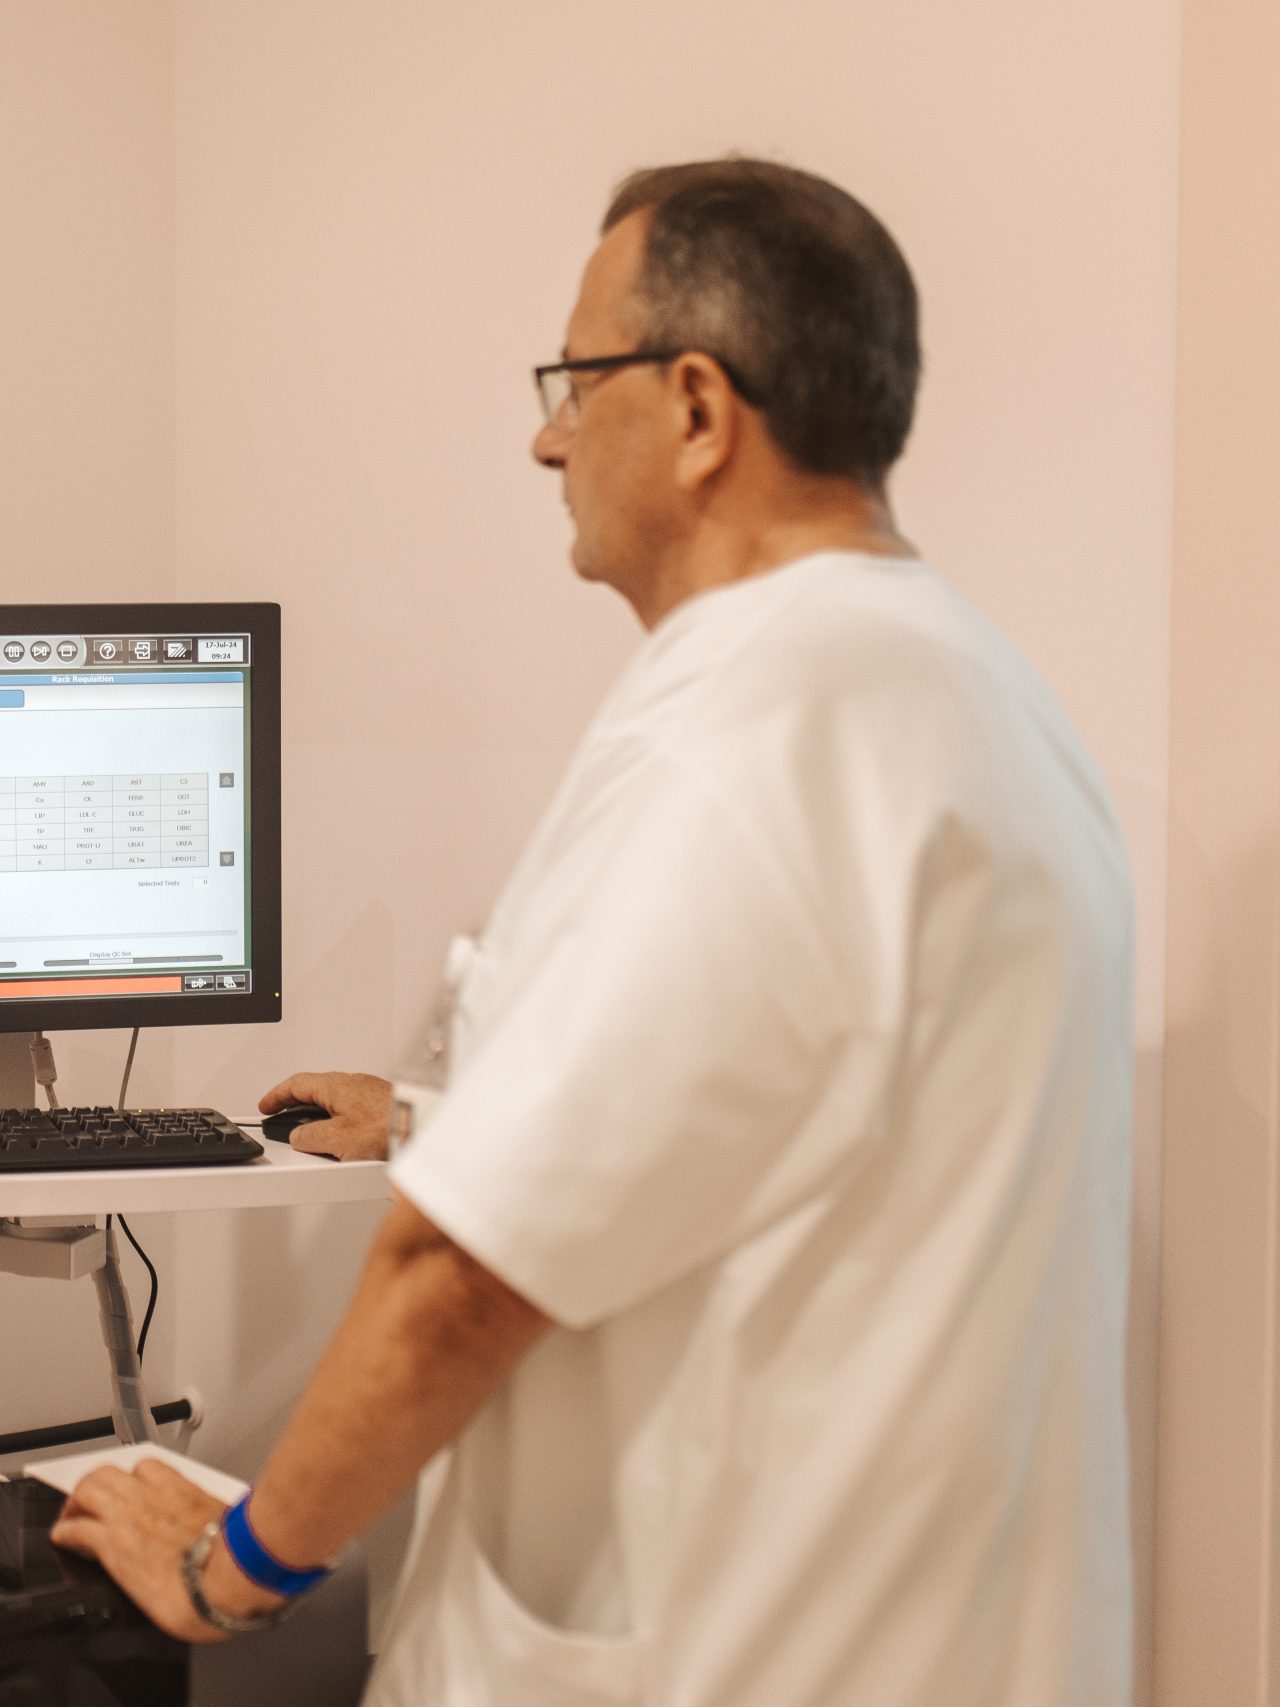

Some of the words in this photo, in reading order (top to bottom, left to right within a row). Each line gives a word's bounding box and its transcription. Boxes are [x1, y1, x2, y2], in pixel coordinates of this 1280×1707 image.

[205, 641, 237, 649] 17-Jul-24
[211, 652, 231, 660] 09:24
[51, 675, 71, 684] Rack
[72, 675, 114, 684] Requisition
[89, 951, 111, 959] Display
[111, 950, 121, 958] QC
